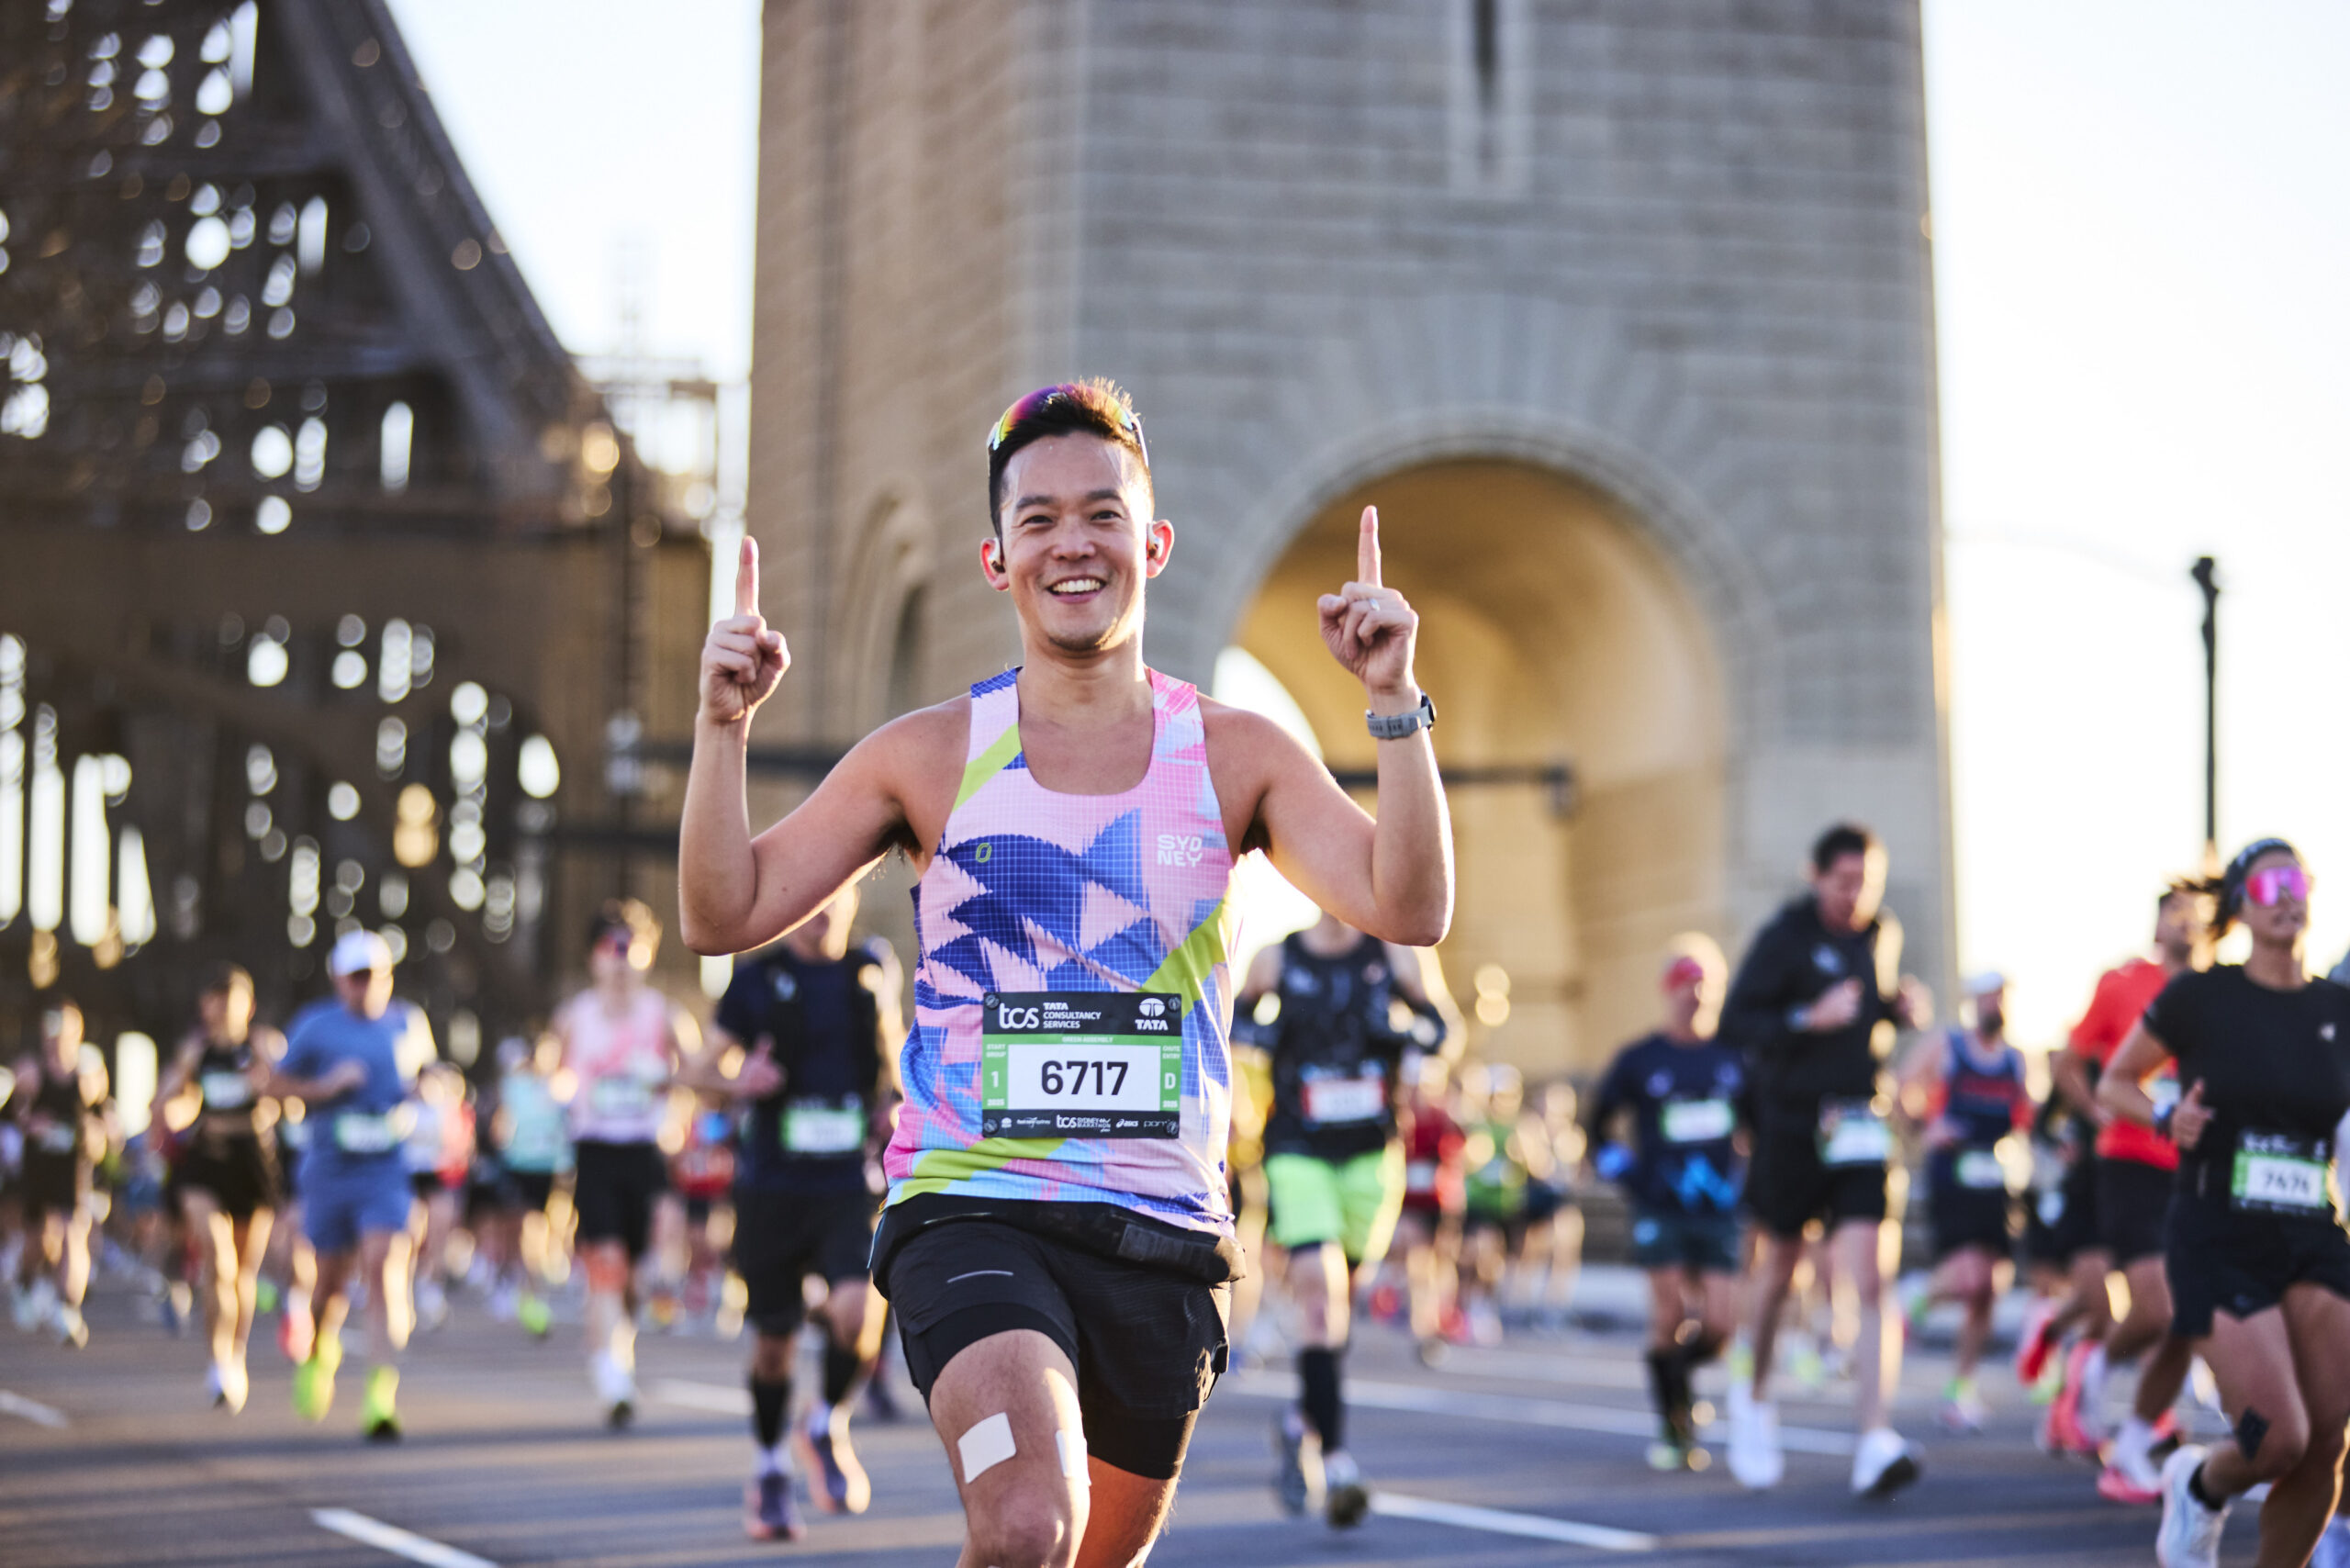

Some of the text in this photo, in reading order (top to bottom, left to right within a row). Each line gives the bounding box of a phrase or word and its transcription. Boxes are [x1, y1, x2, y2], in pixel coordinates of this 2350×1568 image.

[1158, 834, 1203, 852] SYD
[1158, 850, 1203, 868] NEY
[999, 1002, 1040, 1029] tcs
[1043, 1002, 1069, 1011] TATA
[1043, 1012, 1102, 1020] CONSULTANCY
[1043, 1021, 1080, 1029] SERVICES
[1135, 1019, 1169, 1031] TATA
[990, 1070, 999, 1088] 1
[1041, 1060, 1129, 1096] 6717
[1164, 1072, 1177, 1090] D
[1057, 1114, 1077, 1128] tcs
